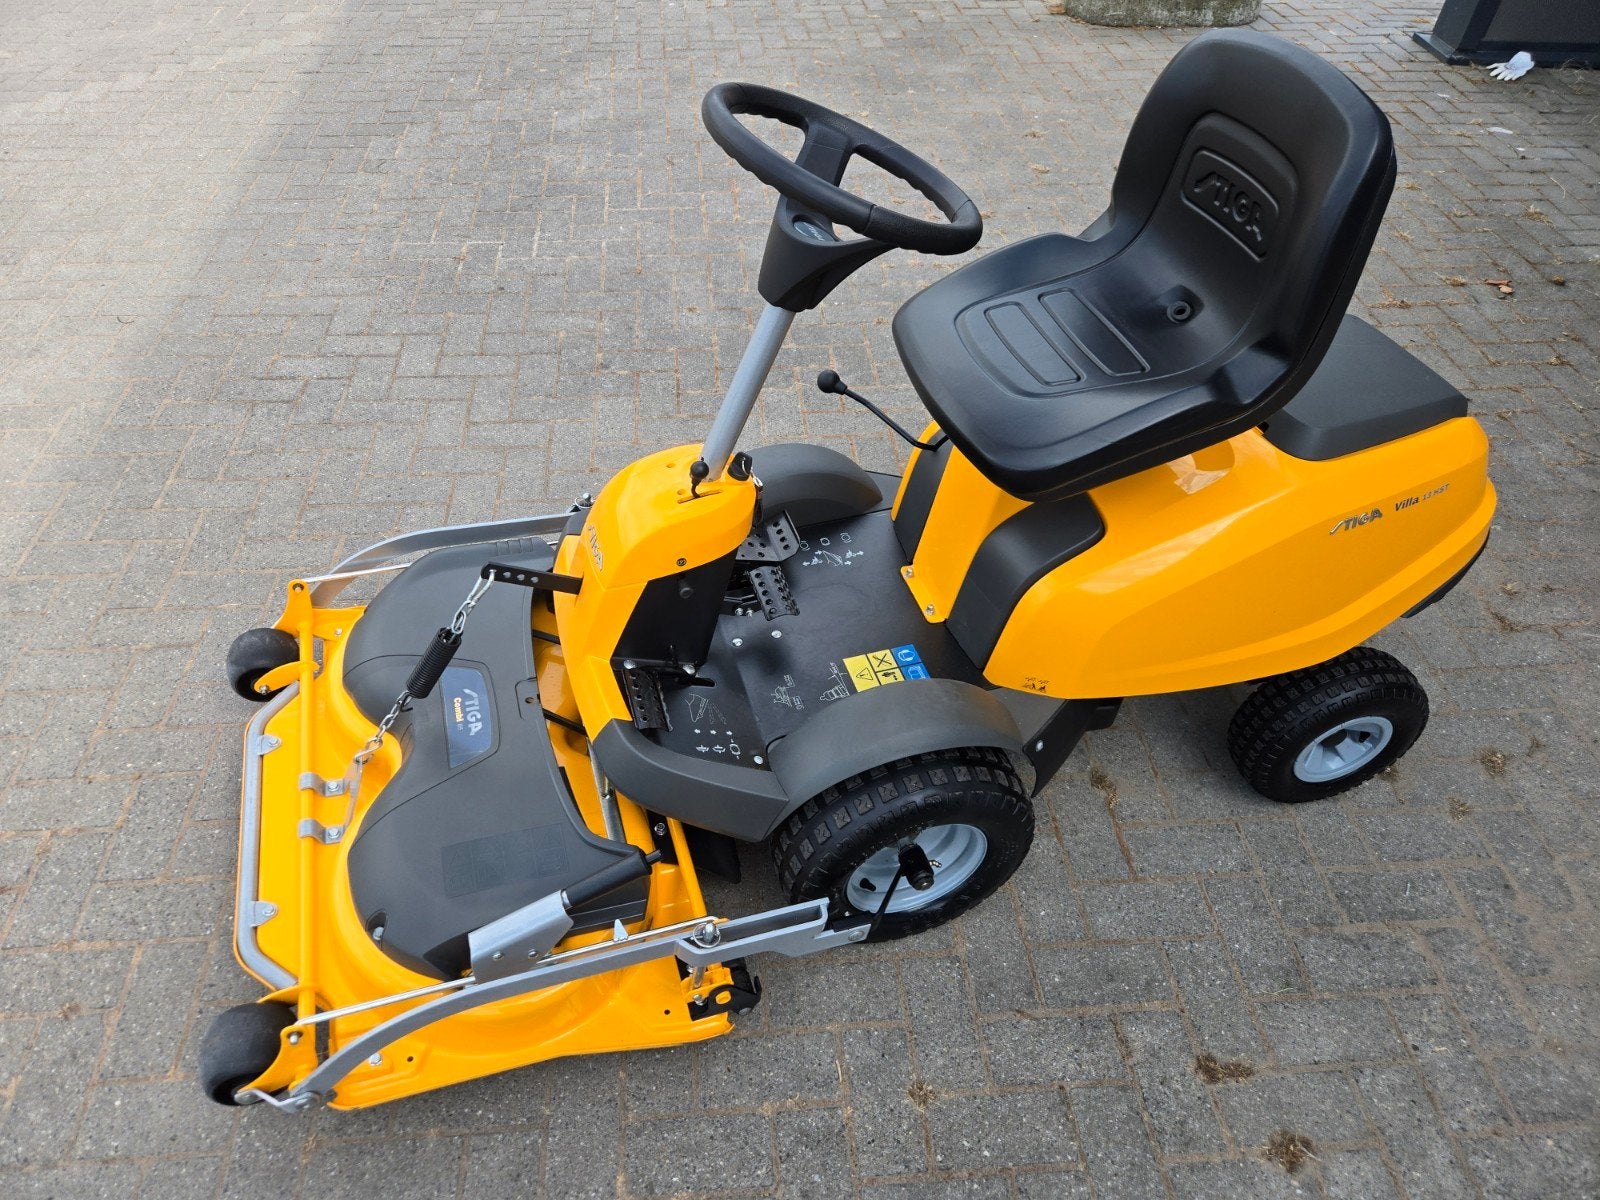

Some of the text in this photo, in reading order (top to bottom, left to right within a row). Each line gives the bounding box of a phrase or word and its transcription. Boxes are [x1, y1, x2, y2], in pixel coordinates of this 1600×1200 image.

[1193, 171, 1264, 242] STIGA
[1329, 508, 1383, 535] STIGA
[1395, 496, 1419, 511] Villa
[454, 697, 464, 722] Combi
[463, 688, 483, 736] STIGA
